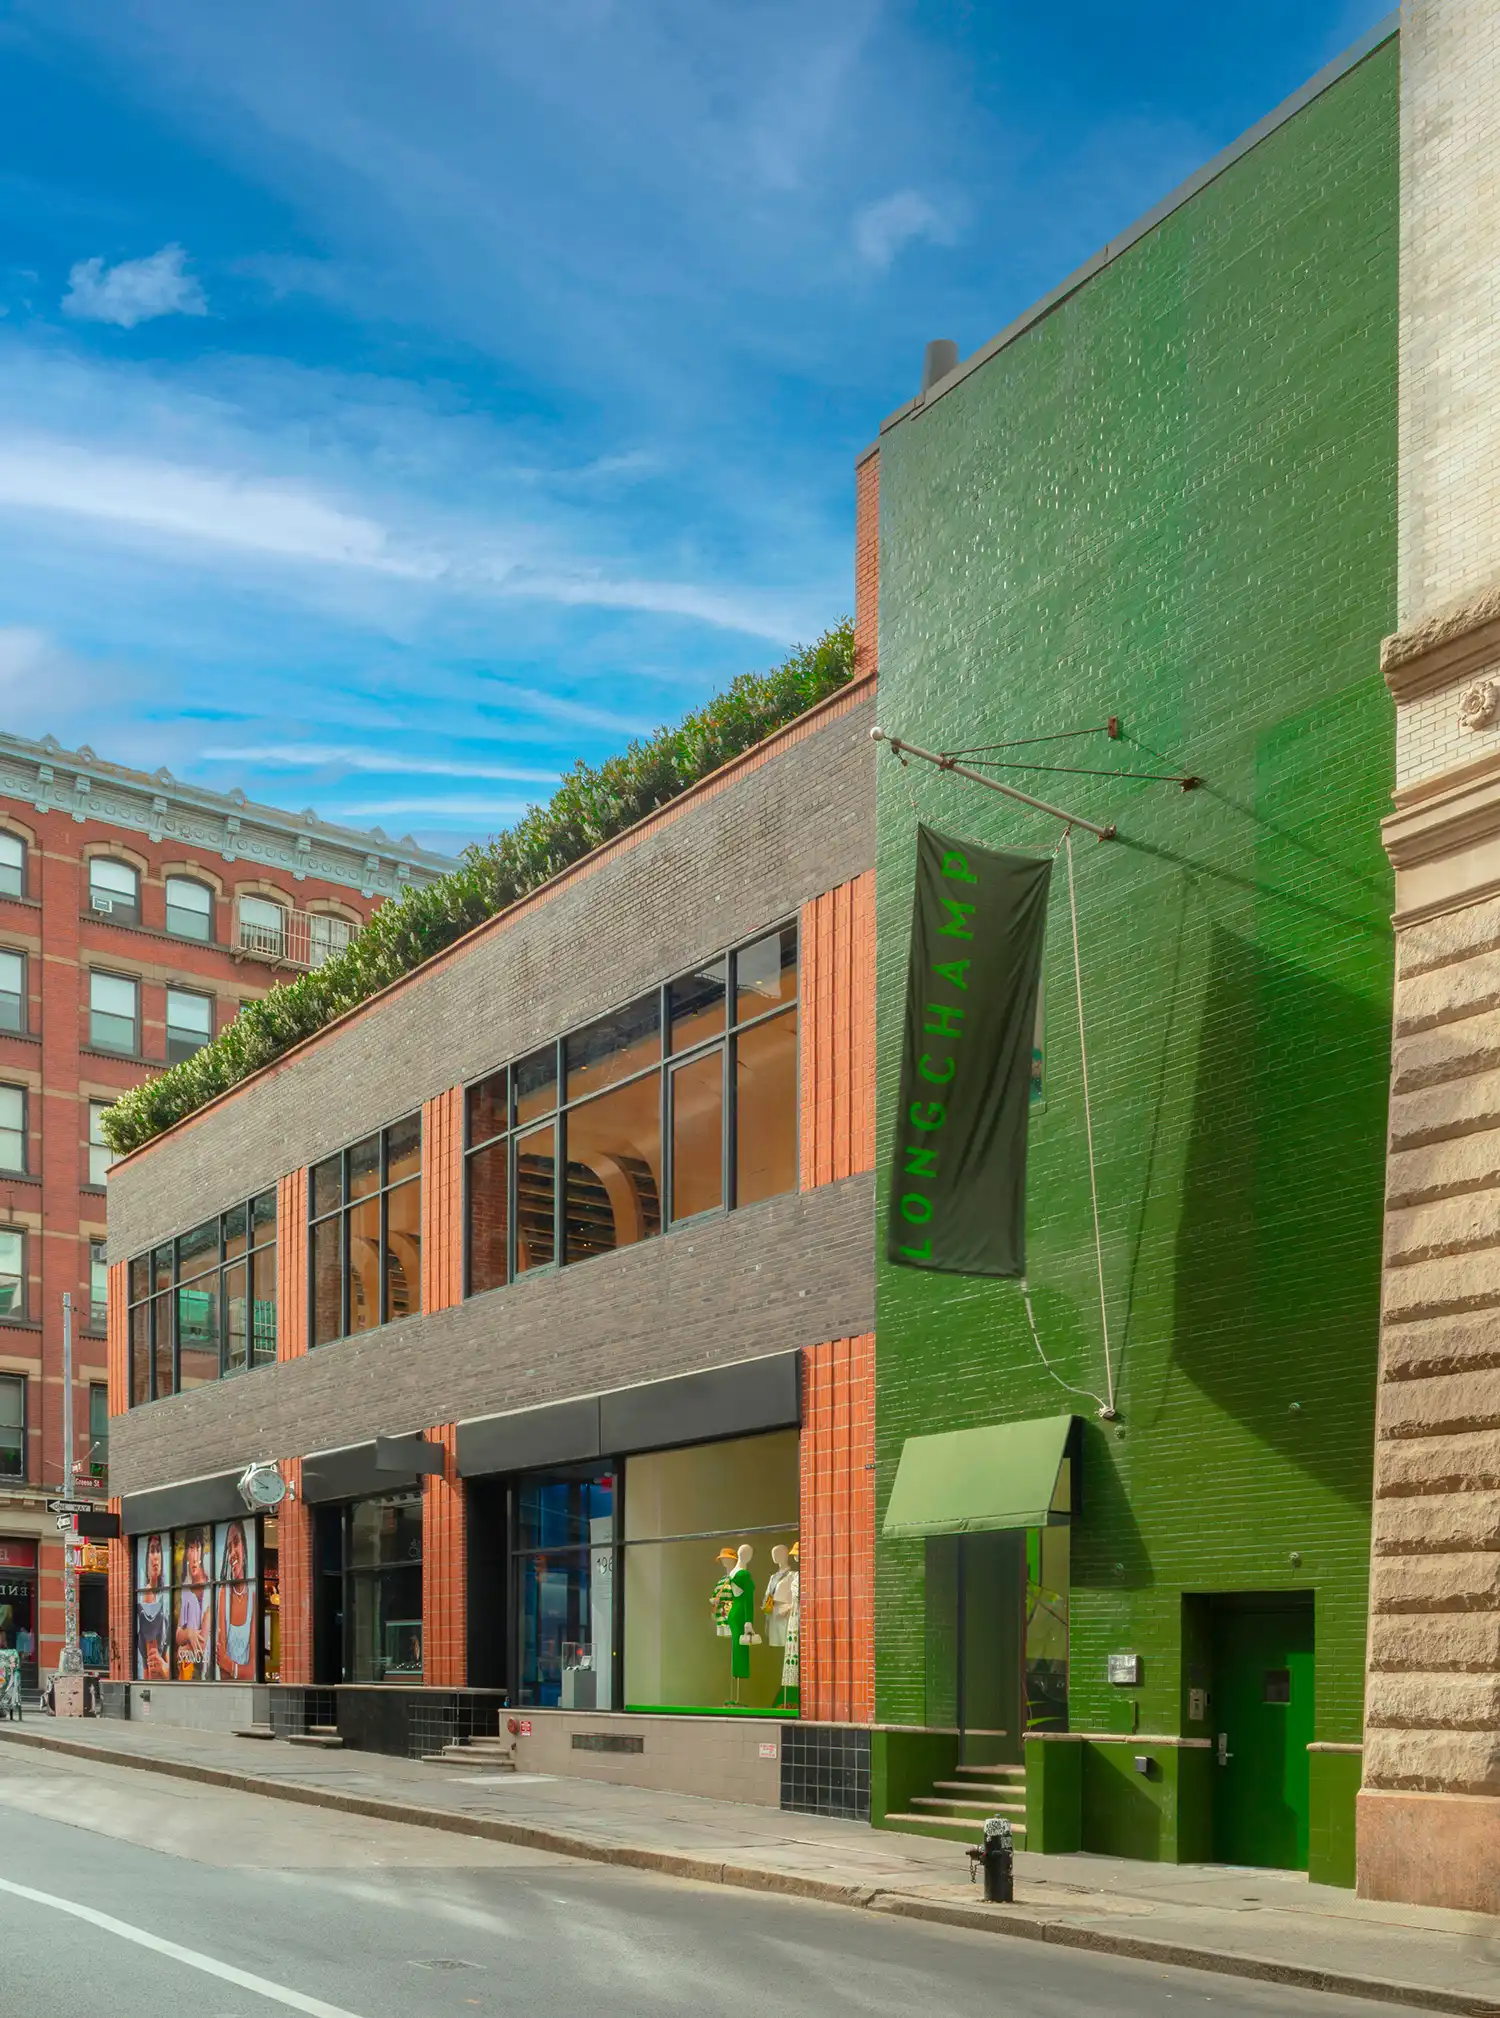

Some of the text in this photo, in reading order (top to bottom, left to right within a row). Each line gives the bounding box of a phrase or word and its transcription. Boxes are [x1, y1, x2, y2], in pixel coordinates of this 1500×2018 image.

[900, 850, 978, 1261] LONGCHAMP
[76, 1478, 100, 1488] Greene St
